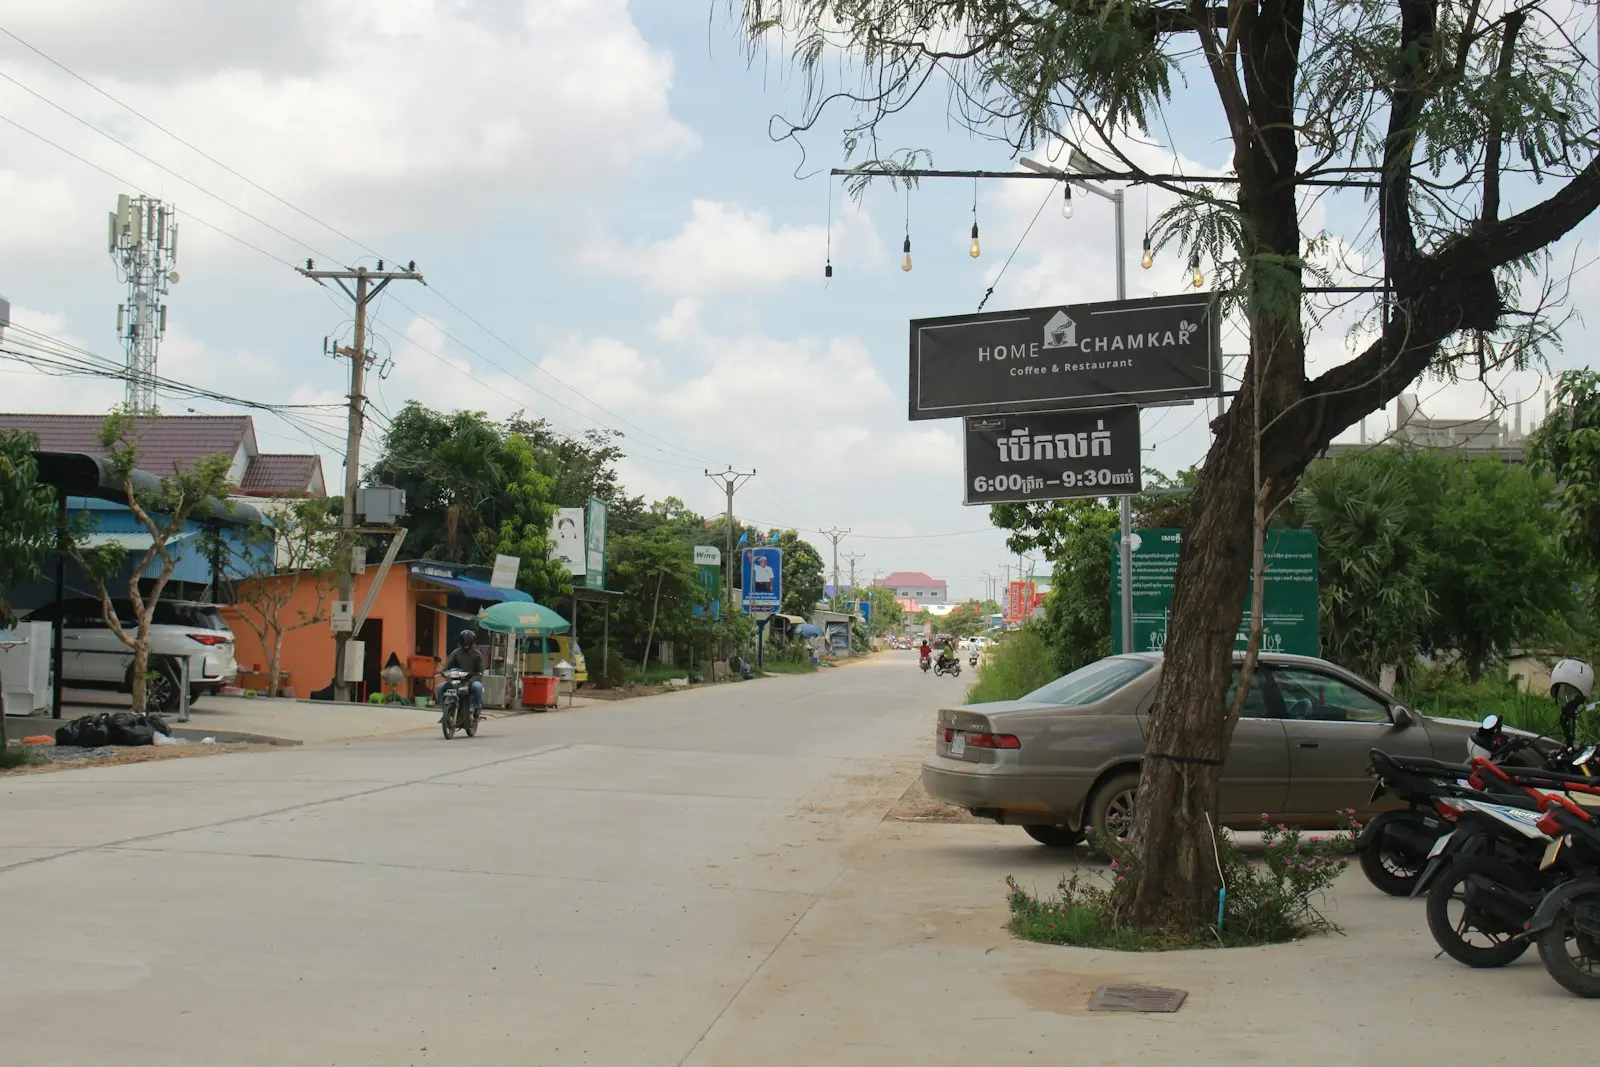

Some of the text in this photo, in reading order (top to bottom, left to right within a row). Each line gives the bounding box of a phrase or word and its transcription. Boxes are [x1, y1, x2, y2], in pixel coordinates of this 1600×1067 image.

[978, 330, 1191, 362] HOME CHAMKAR
[1010, 359, 1133, 376] Coffee & Restaurant
[997, 419, 1112, 462] បើកលក់
[696, 551, 716, 561] Wing
